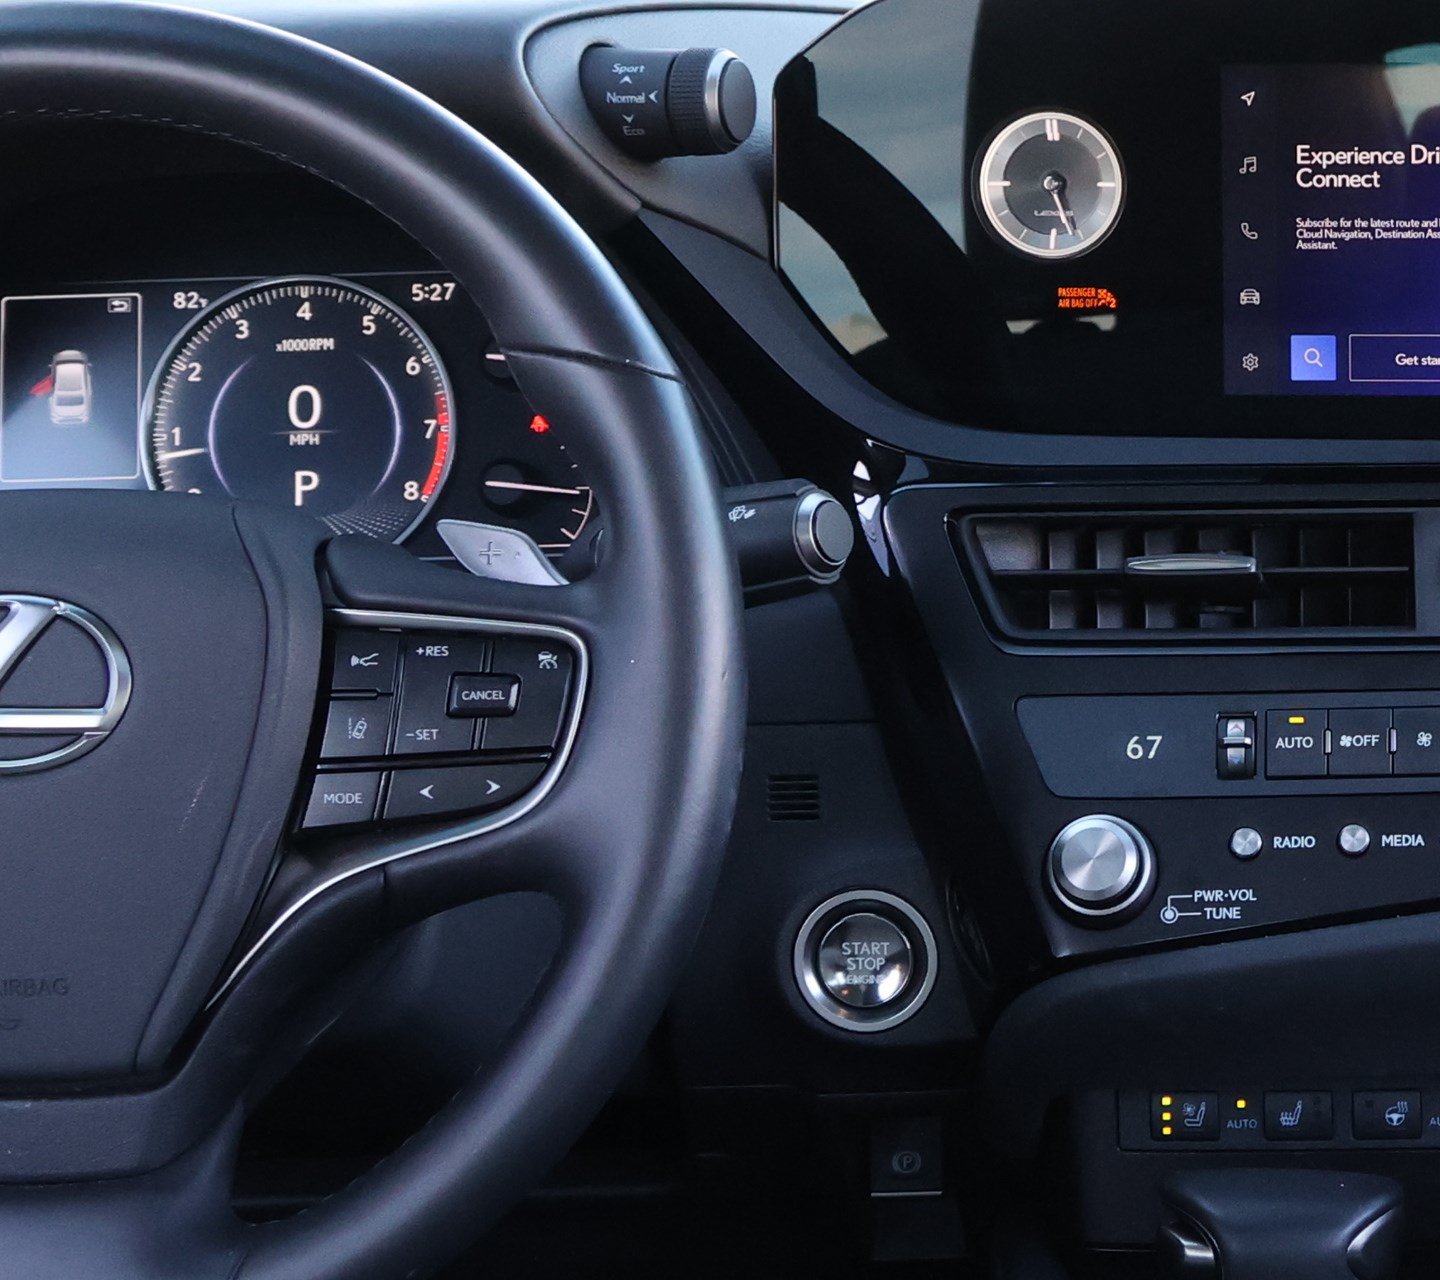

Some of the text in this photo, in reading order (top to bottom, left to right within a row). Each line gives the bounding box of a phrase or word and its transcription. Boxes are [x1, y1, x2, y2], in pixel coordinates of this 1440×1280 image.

[611, 62, 645, 74] Sport
[606, 91, 645, 105] Normal
[622, 125, 645, 136] Eco
[1296, 144, 1405, 169] Experience
[1296, 167, 1380, 188] Connect
[1296, 218, 1338, 229] Subscribe
[1340, 218, 1352, 229] for
[1355, 218, 1368, 229] the
[1370, 218, 1394, 229] latest
[1396, 218, 1420, 229] route
[1421, 218, 1438, 229] and
[1296, 229, 1323, 240] Cloud
[1324, 229, 1373, 240] Navigation,
[1375, 229, 1425, 240] Destination
[1296, 240, 1338, 250] Assistant.
[410, 283, 456, 302] 5:27
[1057, 287, 1096, 297] PASSENGER
[1058, 299, 1069, 307] AIR
[1071, 298, 1084, 308] BAG
[296, 302, 313, 321] 4
[234, 320, 251, 340] 3
[361, 316, 376, 336] 5
[275, 337, 335, 353] x1000RPM
[405, 356, 420, 376] 6
[1395, 352, 1418, 367] Get
[186, 362, 202, 382] 2
[287, 385, 323, 430] 0
[170, 426, 182, 447] 1
[423, 419, 437, 440] 7
[288, 432, 321, 447] MPH
[293, 470, 320, 507] P
[403, 481, 419, 501] 8
[461, 690, 506, 701] CANCEL
[1125, 735, 1163, 760] 67
[1275, 735, 1314, 750] AUTO
[1352, 734, 1380, 748] OFF
[323, 792, 363, 805] MODE
[1273, 835, 1316, 850] RADIO
[1381, 833, 1425, 848] MEDIA
[1203, 907, 1242, 921] TUNE
[841, 941, 890, 956] START
[846, 957, 886, 971] STOP
[1226, 1119, 1258, 1130] AUTO
